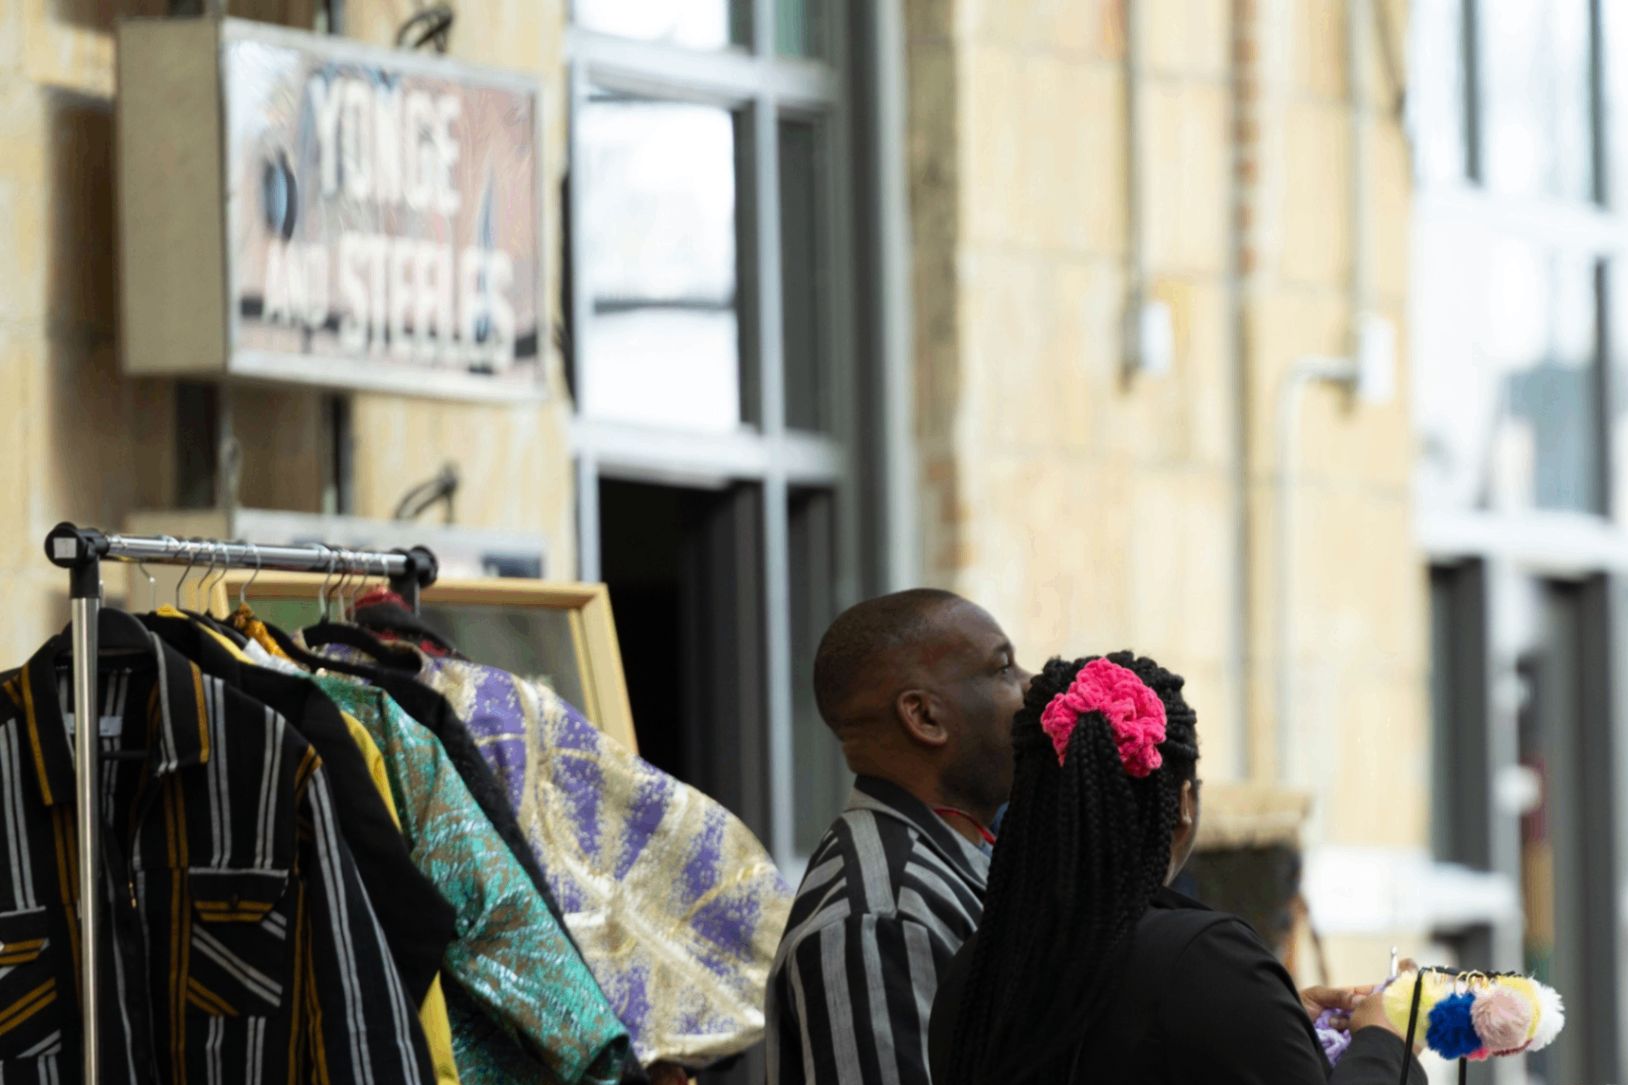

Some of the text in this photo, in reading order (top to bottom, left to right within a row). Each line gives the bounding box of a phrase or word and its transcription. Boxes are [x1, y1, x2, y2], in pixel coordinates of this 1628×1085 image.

[308, 77, 460, 214] YONGE
[263, 231, 515, 367] AND STEELES
